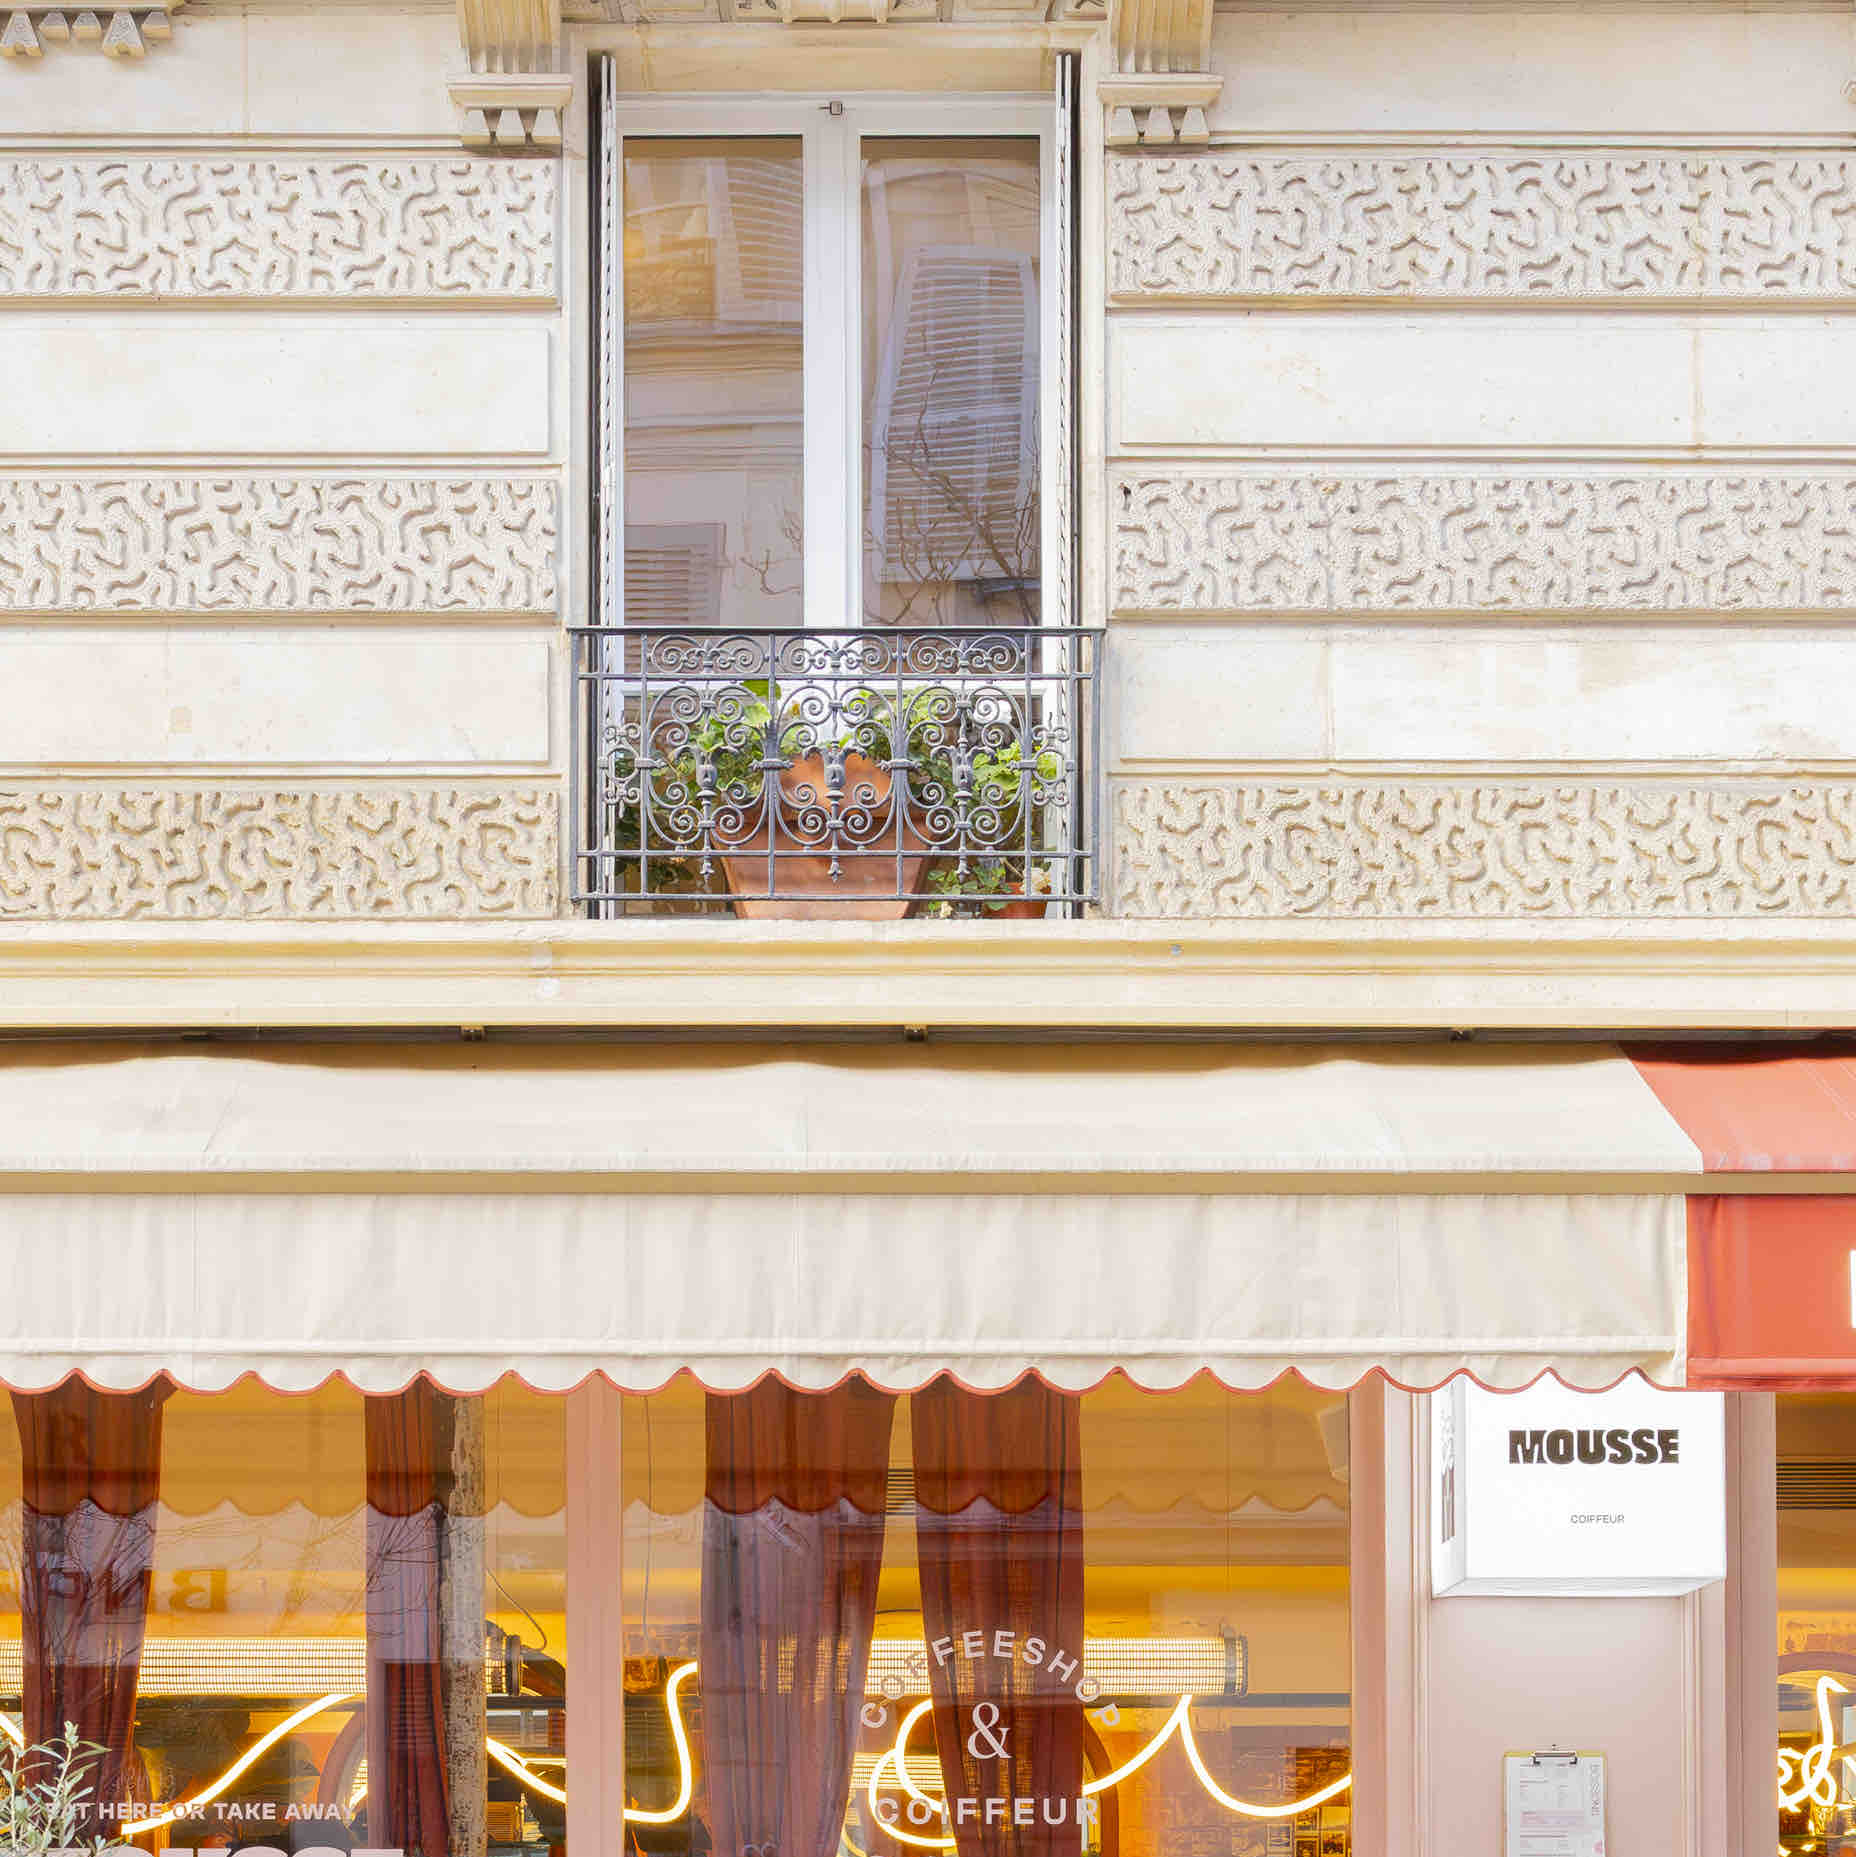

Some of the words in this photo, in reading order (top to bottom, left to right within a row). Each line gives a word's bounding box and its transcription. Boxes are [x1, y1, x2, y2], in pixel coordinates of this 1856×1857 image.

[1508, 1429, 1680, 1465] MOUSSE
[1570, 1514, 1625, 1524] COIFFEUR
[860, 1630, 1121, 1729] COFFEESHOP
[967, 1702, 1013, 1759] &
[99, 1802, 163, 1820] HERE
[174, 1802, 205, 1820] OR
[213, 1802, 276, 1820] TAKE
[285, 1802, 357, 1820] AWAY
[874, 1798, 1098, 1825] COIFFEUR
